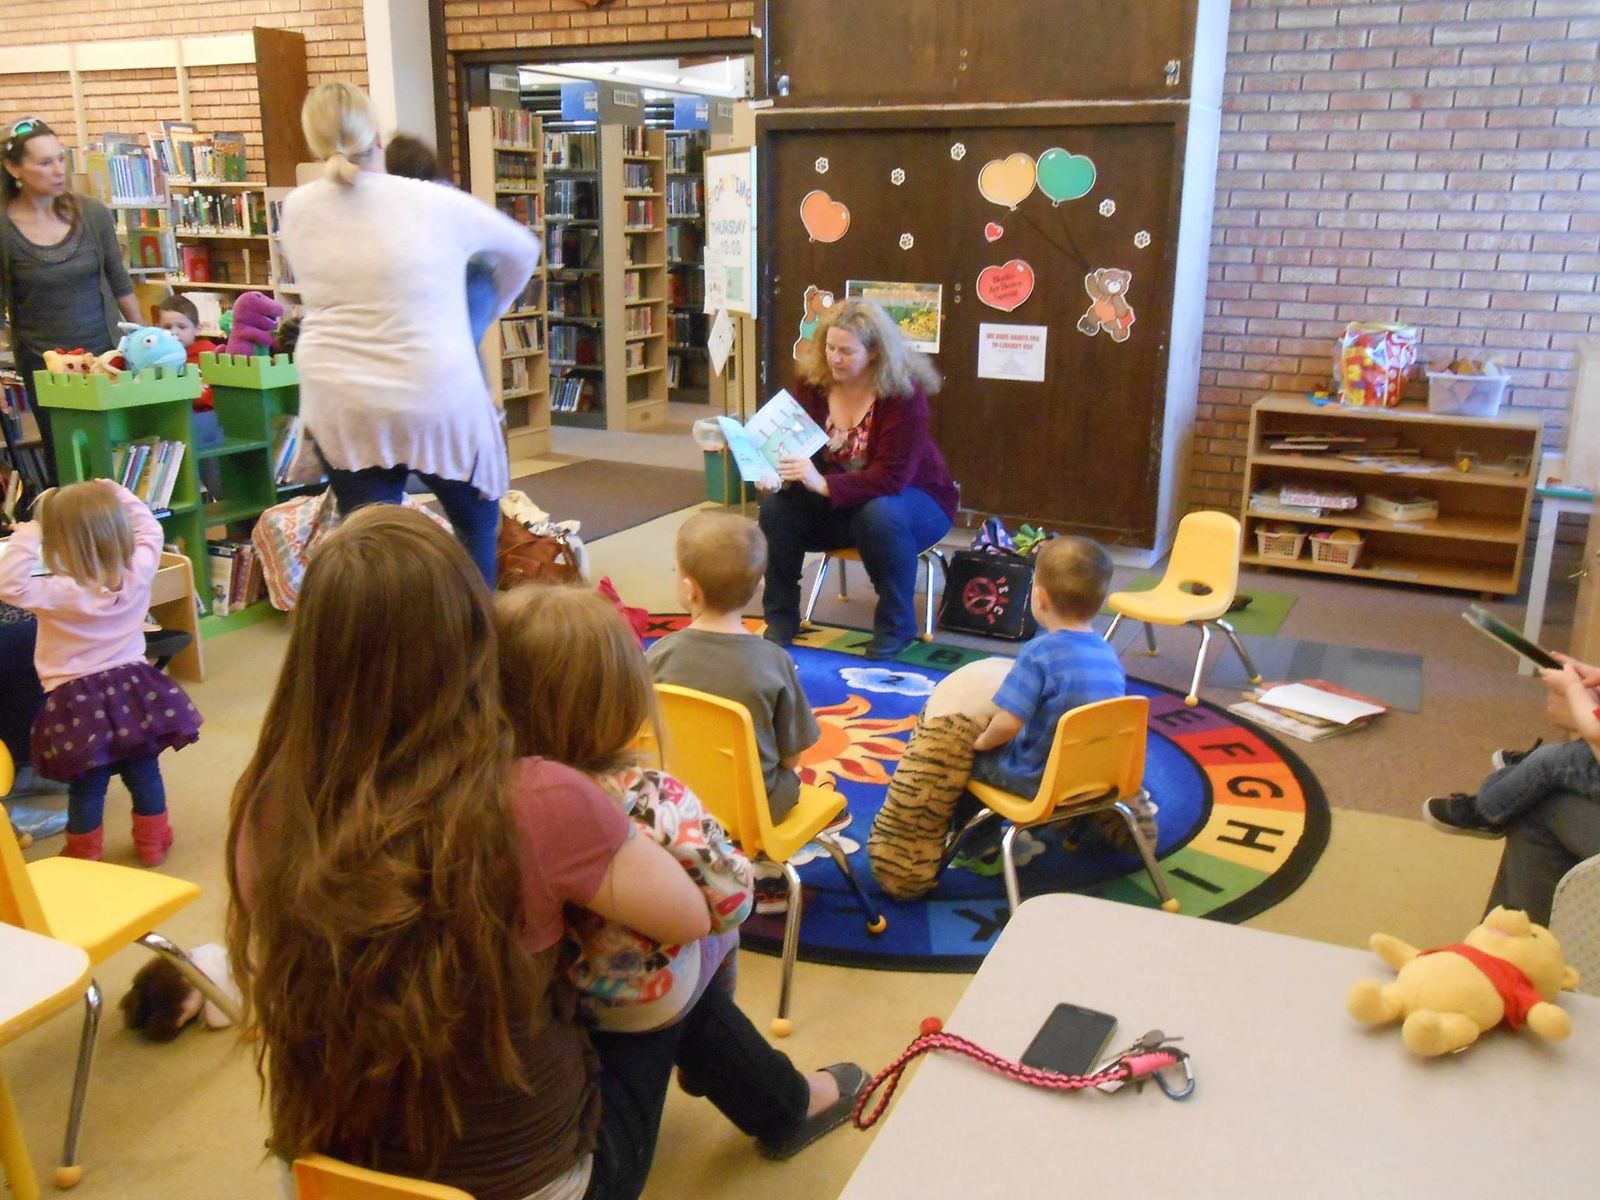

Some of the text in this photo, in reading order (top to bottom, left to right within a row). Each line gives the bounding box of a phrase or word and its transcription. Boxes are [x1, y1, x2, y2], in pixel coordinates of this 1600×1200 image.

[1152, 709, 1206, 727] E
[1198, 742, 1256, 757] F
[1226, 776, 1284, 798] G
[1216, 819, 1285, 853] H
